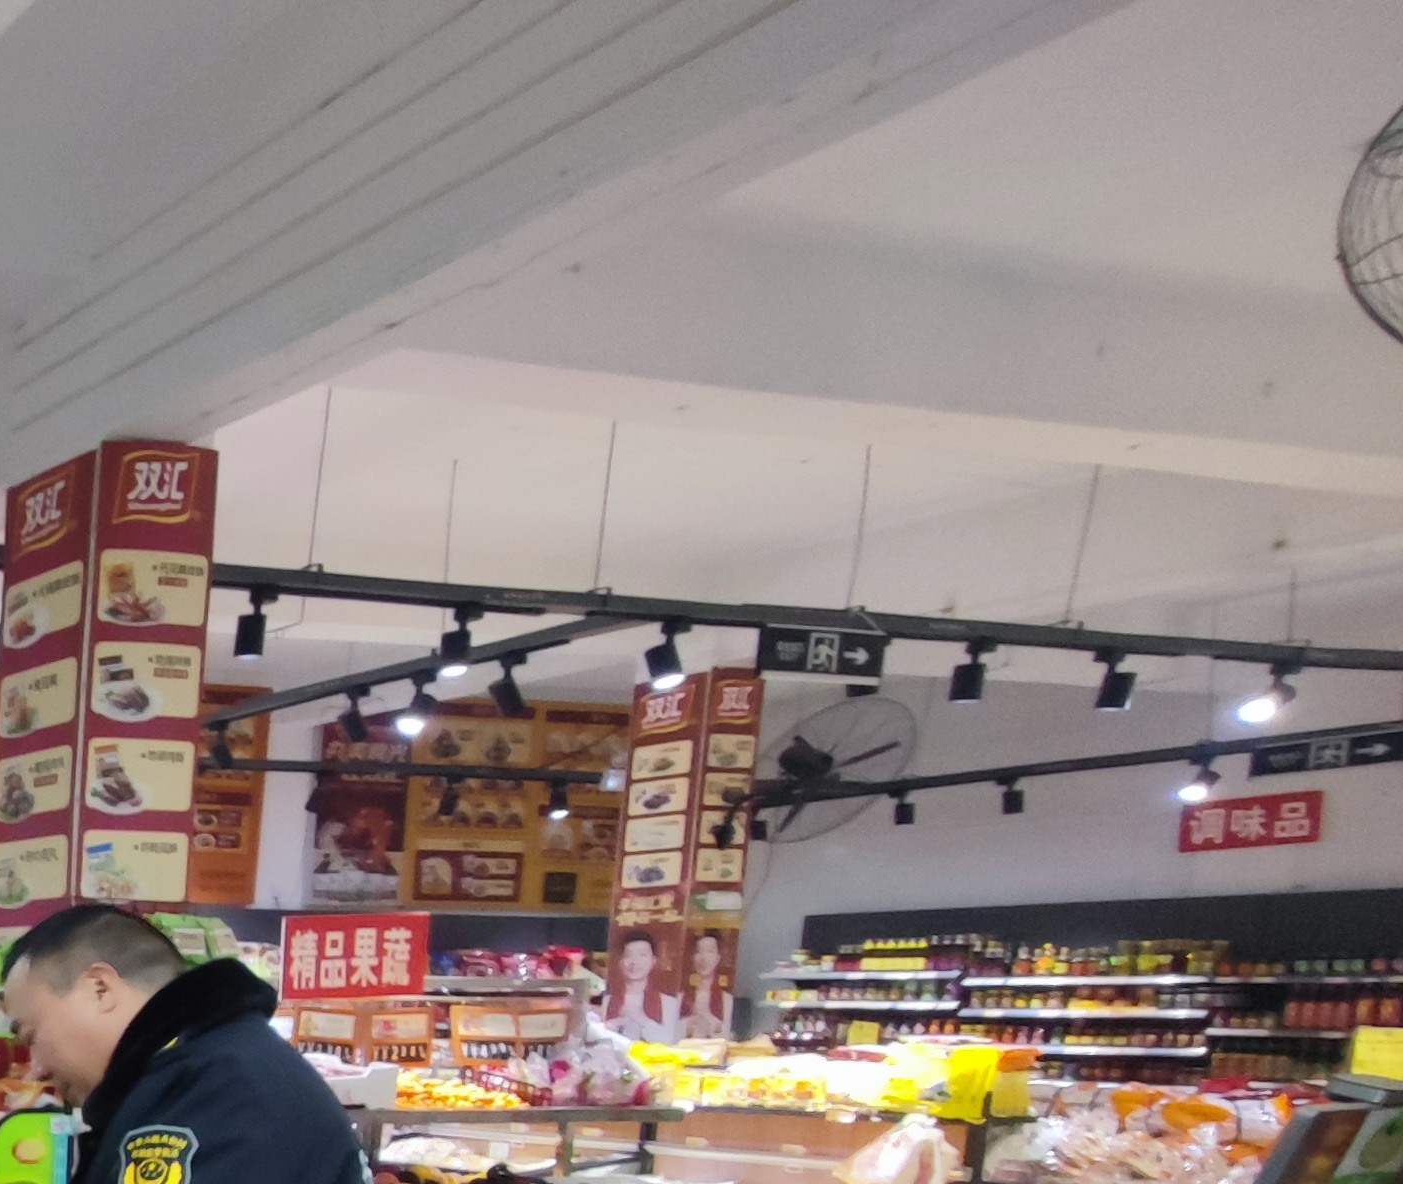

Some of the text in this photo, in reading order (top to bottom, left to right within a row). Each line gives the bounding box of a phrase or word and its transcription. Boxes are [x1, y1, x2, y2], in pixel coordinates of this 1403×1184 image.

[126, 460, 189, 501] 双汇
[24, 479, 67, 531] 双汇
[1189, 804, 1311, 845] 调味品
[289, 926, 412, 990] 精品果蔬
